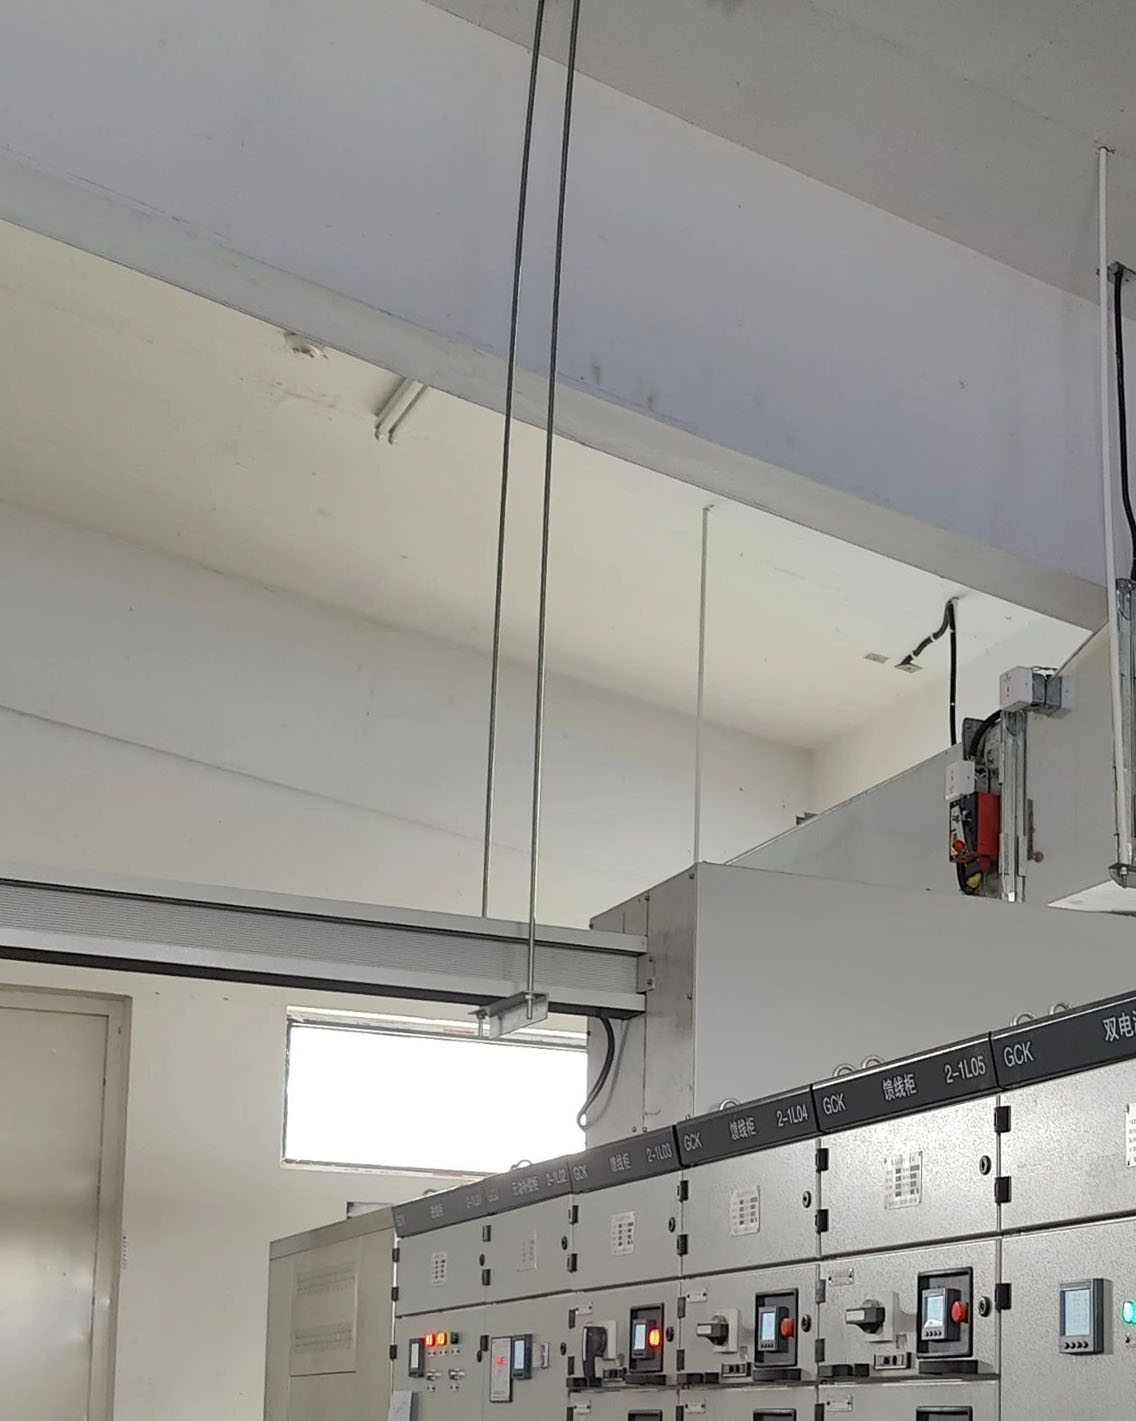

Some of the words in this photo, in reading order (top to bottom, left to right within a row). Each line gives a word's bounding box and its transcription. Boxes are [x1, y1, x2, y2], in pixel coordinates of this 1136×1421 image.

[1003, 1041, 1034, 1067] GCK
[944, 1055, 986, 1084] 2-1L05
[883, 1073, 917, 1101] 馈线柜
[776, 1104, 808, 1128] 2-1L04
[822, 1093, 846, 1115] GCK
[683, 1132, 702, 1152] GCK
